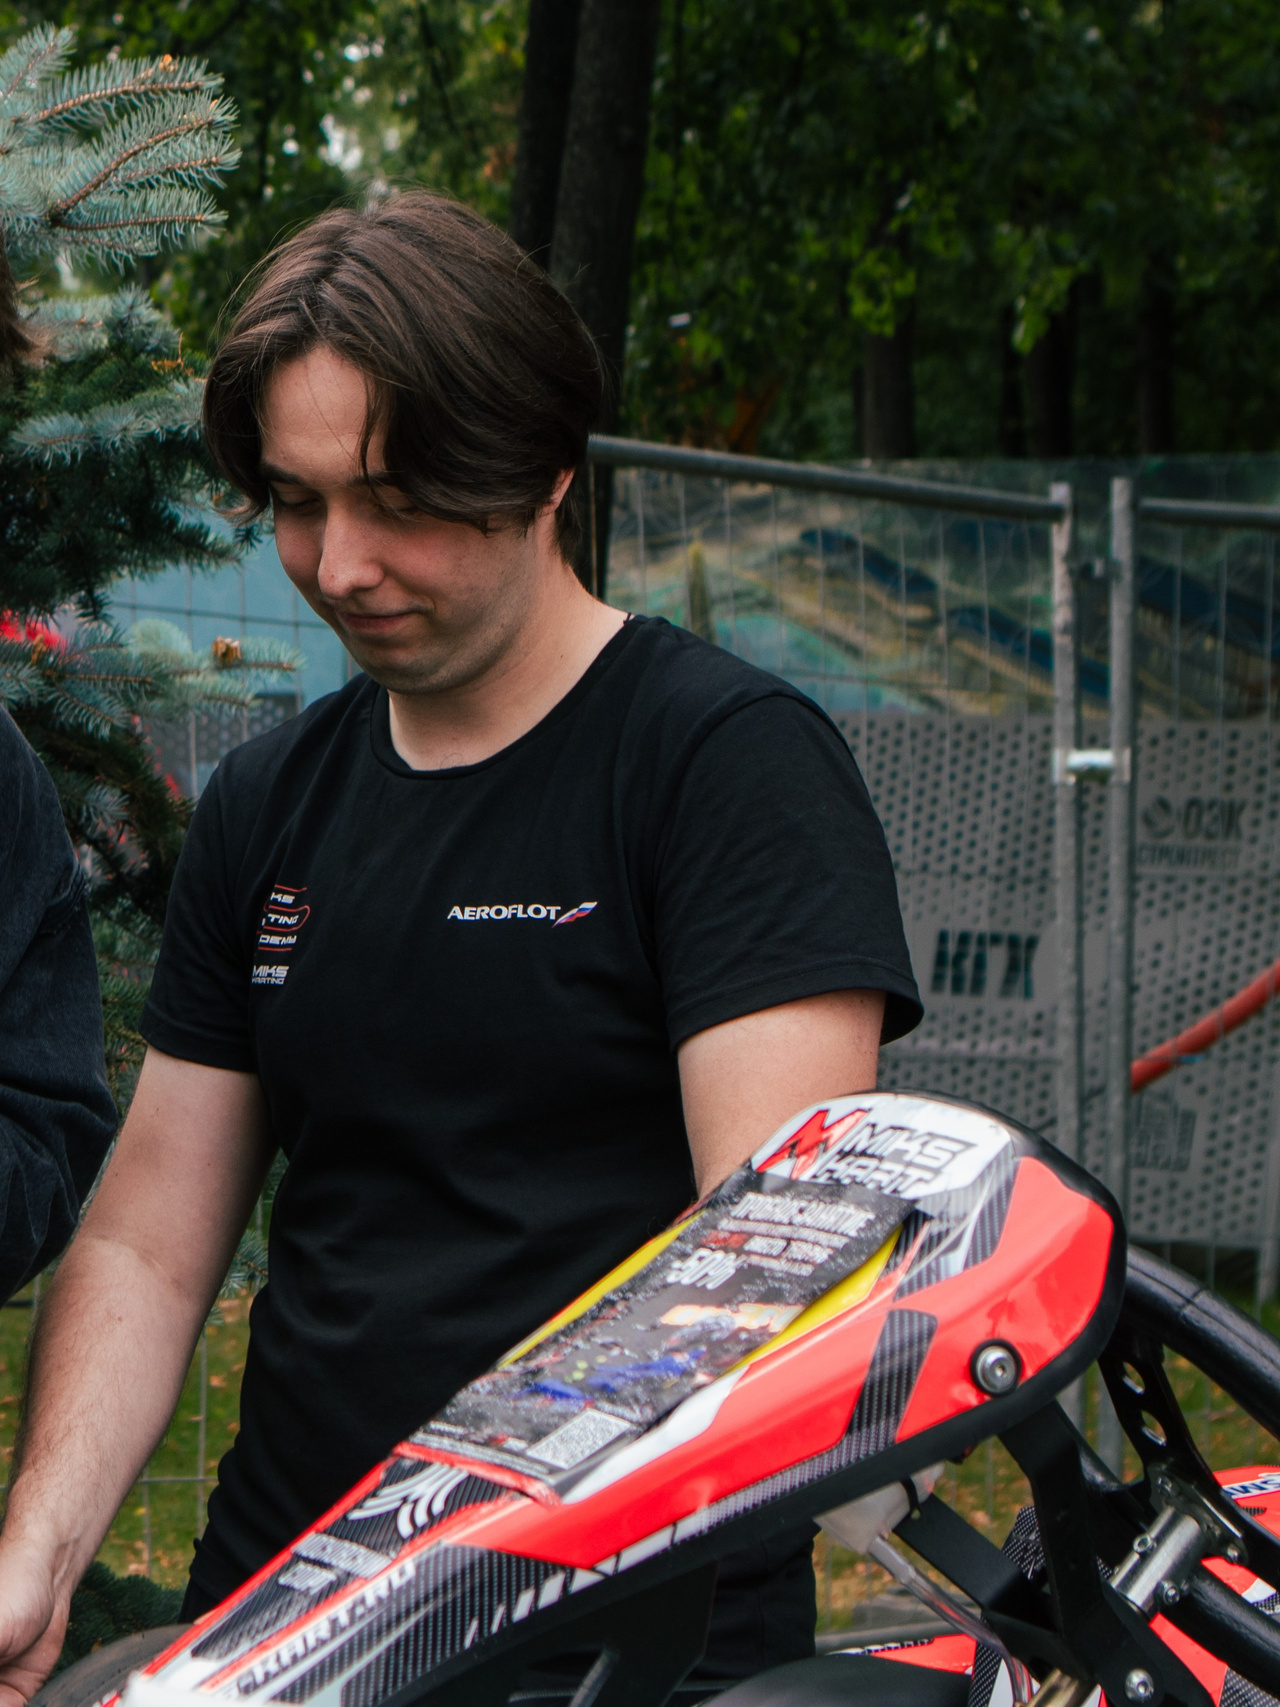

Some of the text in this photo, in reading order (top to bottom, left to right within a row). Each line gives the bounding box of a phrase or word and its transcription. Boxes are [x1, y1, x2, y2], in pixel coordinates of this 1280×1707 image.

[447, 903, 562, 921] AEROFLOT
[252, 965, 289, 978] MIKS
[842, 1122, 976, 1170] MIKS
[812, 1154, 942, 1196] KART
